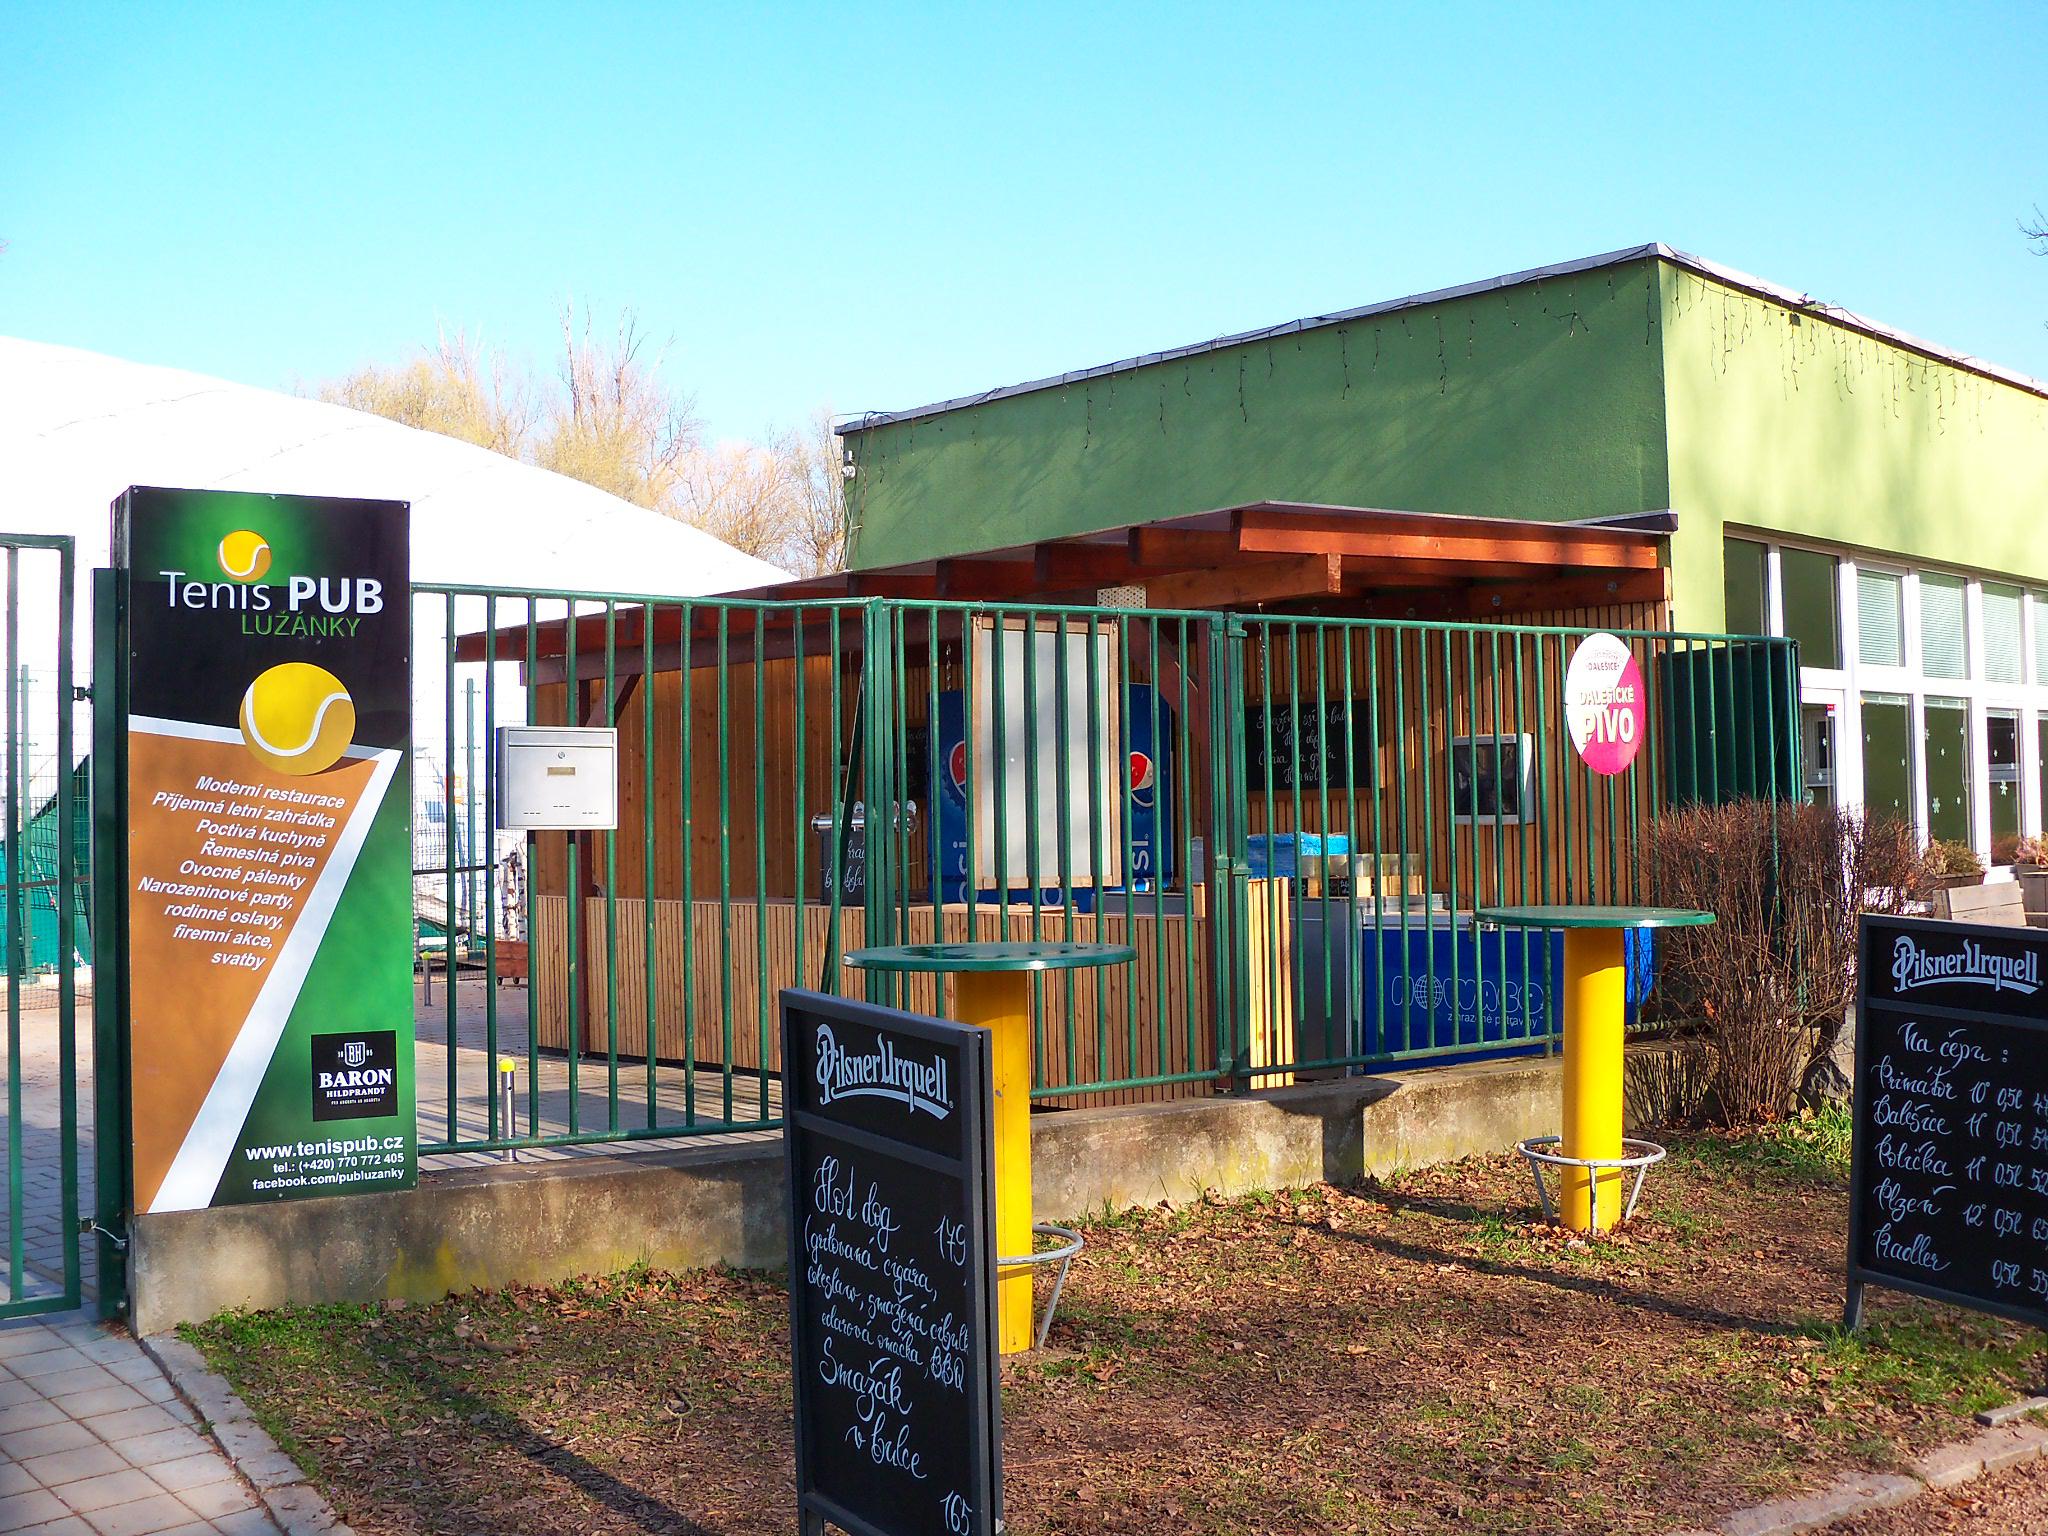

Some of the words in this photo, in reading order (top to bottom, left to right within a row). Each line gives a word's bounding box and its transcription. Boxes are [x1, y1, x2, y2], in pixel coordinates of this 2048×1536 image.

[159, 571, 271, 611] Tenis
[289, 576, 383, 614] PUB
[241, 610, 361, 637] LUŽÁNKY
[1583, 707, 1634, 745] PIVO
[196, 776, 262, 798] Moderní
[263, 791, 346, 809] restaurace
[153, 791, 225, 814] Příjemná
[228, 804, 263, 820] letní
[264, 809, 336, 828] zahrádka
[196, 819, 257, 839] Poctivá
[259, 827, 326, 848] kuchyně
[201, 840, 279, 863] Řemeslná
[280, 852, 315, 869] piva
[180, 860, 241, 880] Ovocné
[242, 868, 306, 890] pálenky
[138, 877, 248, 902] Narozeninové
[250, 891, 294, 909] party,
[165, 903, 228, 921] rodinné
[230, 911, 284, 930] oslavy,
[173, 924, 231, 943] firemní
[233, 934, 273, 950] akce,
[211, 951, 266, 970] svatby
[1892, 936, 1966, 993] Pilsner
[1963, 938, 2038, 992] Urquell
[1898, 1022, 1934, 1052] Na
[319, 1068, 392, 1088] BARON
[816, 1023, 881, 1105] Pilsner
[877, 1033, 948, 1114] Urquell
[1871, 1055, 1958, 1100] Primátor
[326, 1087, 386, 1098] HILDPRANDT
[246, 1136, 404, 1161] www.tenispub.cz
[273, 1162, 296, 1174] tel.:
[298, 1159, 335, 1173] (+420)
[338, 1157, 358, 1169] 770
[361, 1155, 381, 1167] 772
[384, 1153, 404, 1165] 405
[252, 1167, 405, 1190] facebook.com/publuzanky
[814, 1155, 857, 1221] Hot
[862, 1182, 901, 1252] dog
[819, 1336, 912, 1422] Smažák
[871, 1412, 928, 1479] bulce
